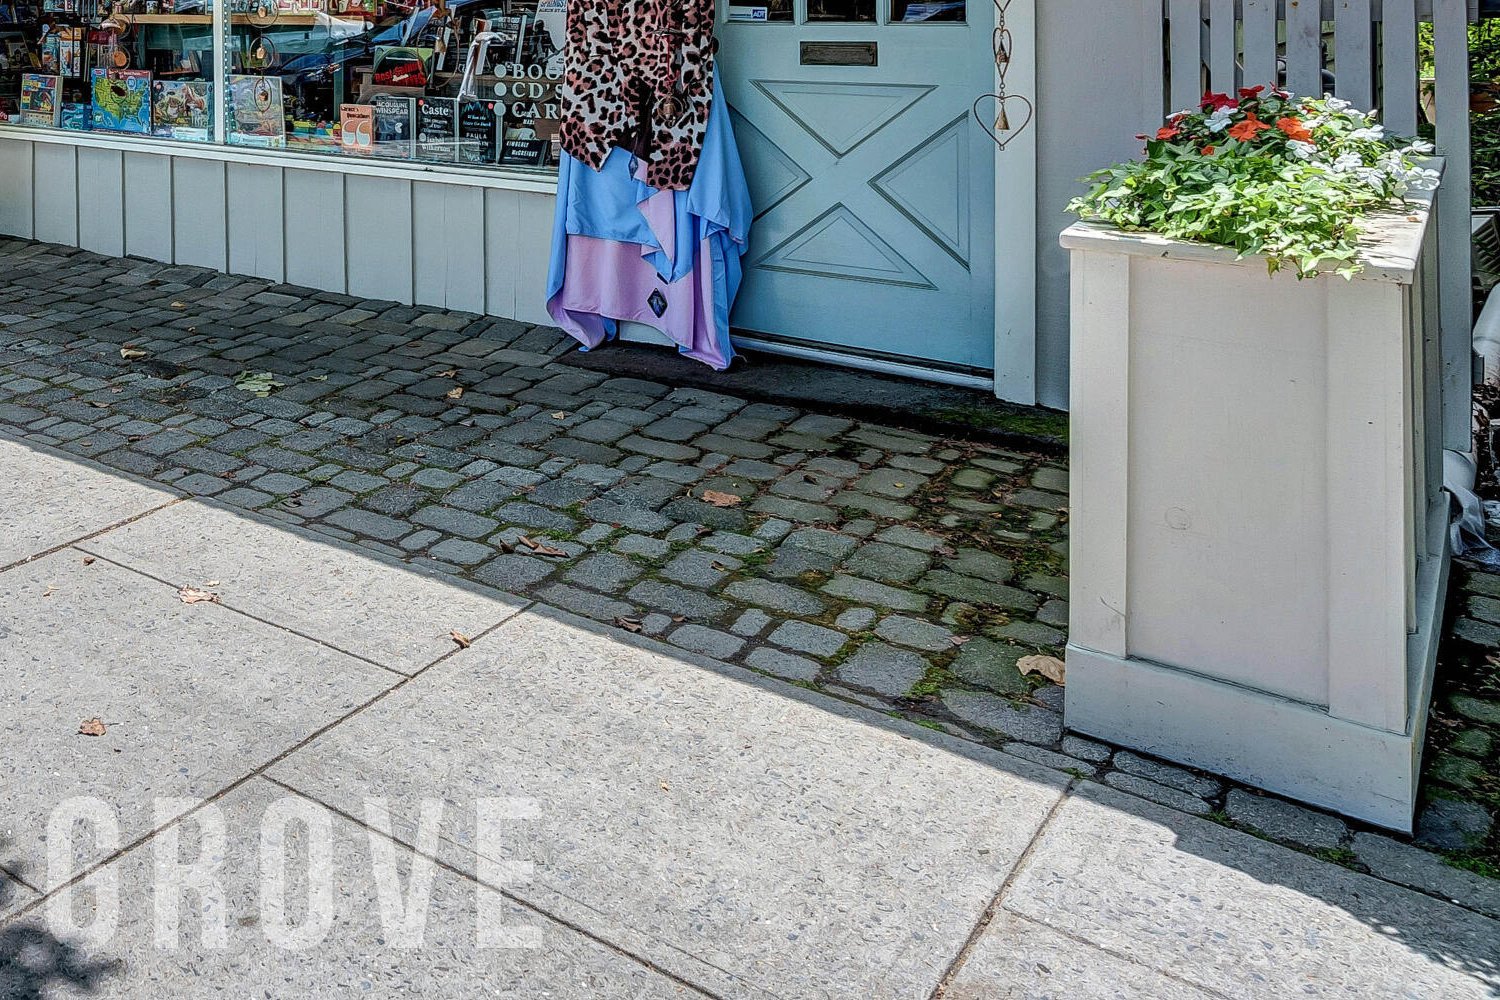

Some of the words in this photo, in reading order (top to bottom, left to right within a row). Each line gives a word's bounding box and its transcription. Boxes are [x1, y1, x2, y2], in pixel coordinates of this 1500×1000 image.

[511, 63, 562, 81] BOO
[511, 82, 563, 100] CD'S
[376, 107, 409, 115] WINSPEAR
[421, 103, 449, 116] Caste
[511, 101, 560, 120] CAR
[465, 132, 488, 140] PAULA
